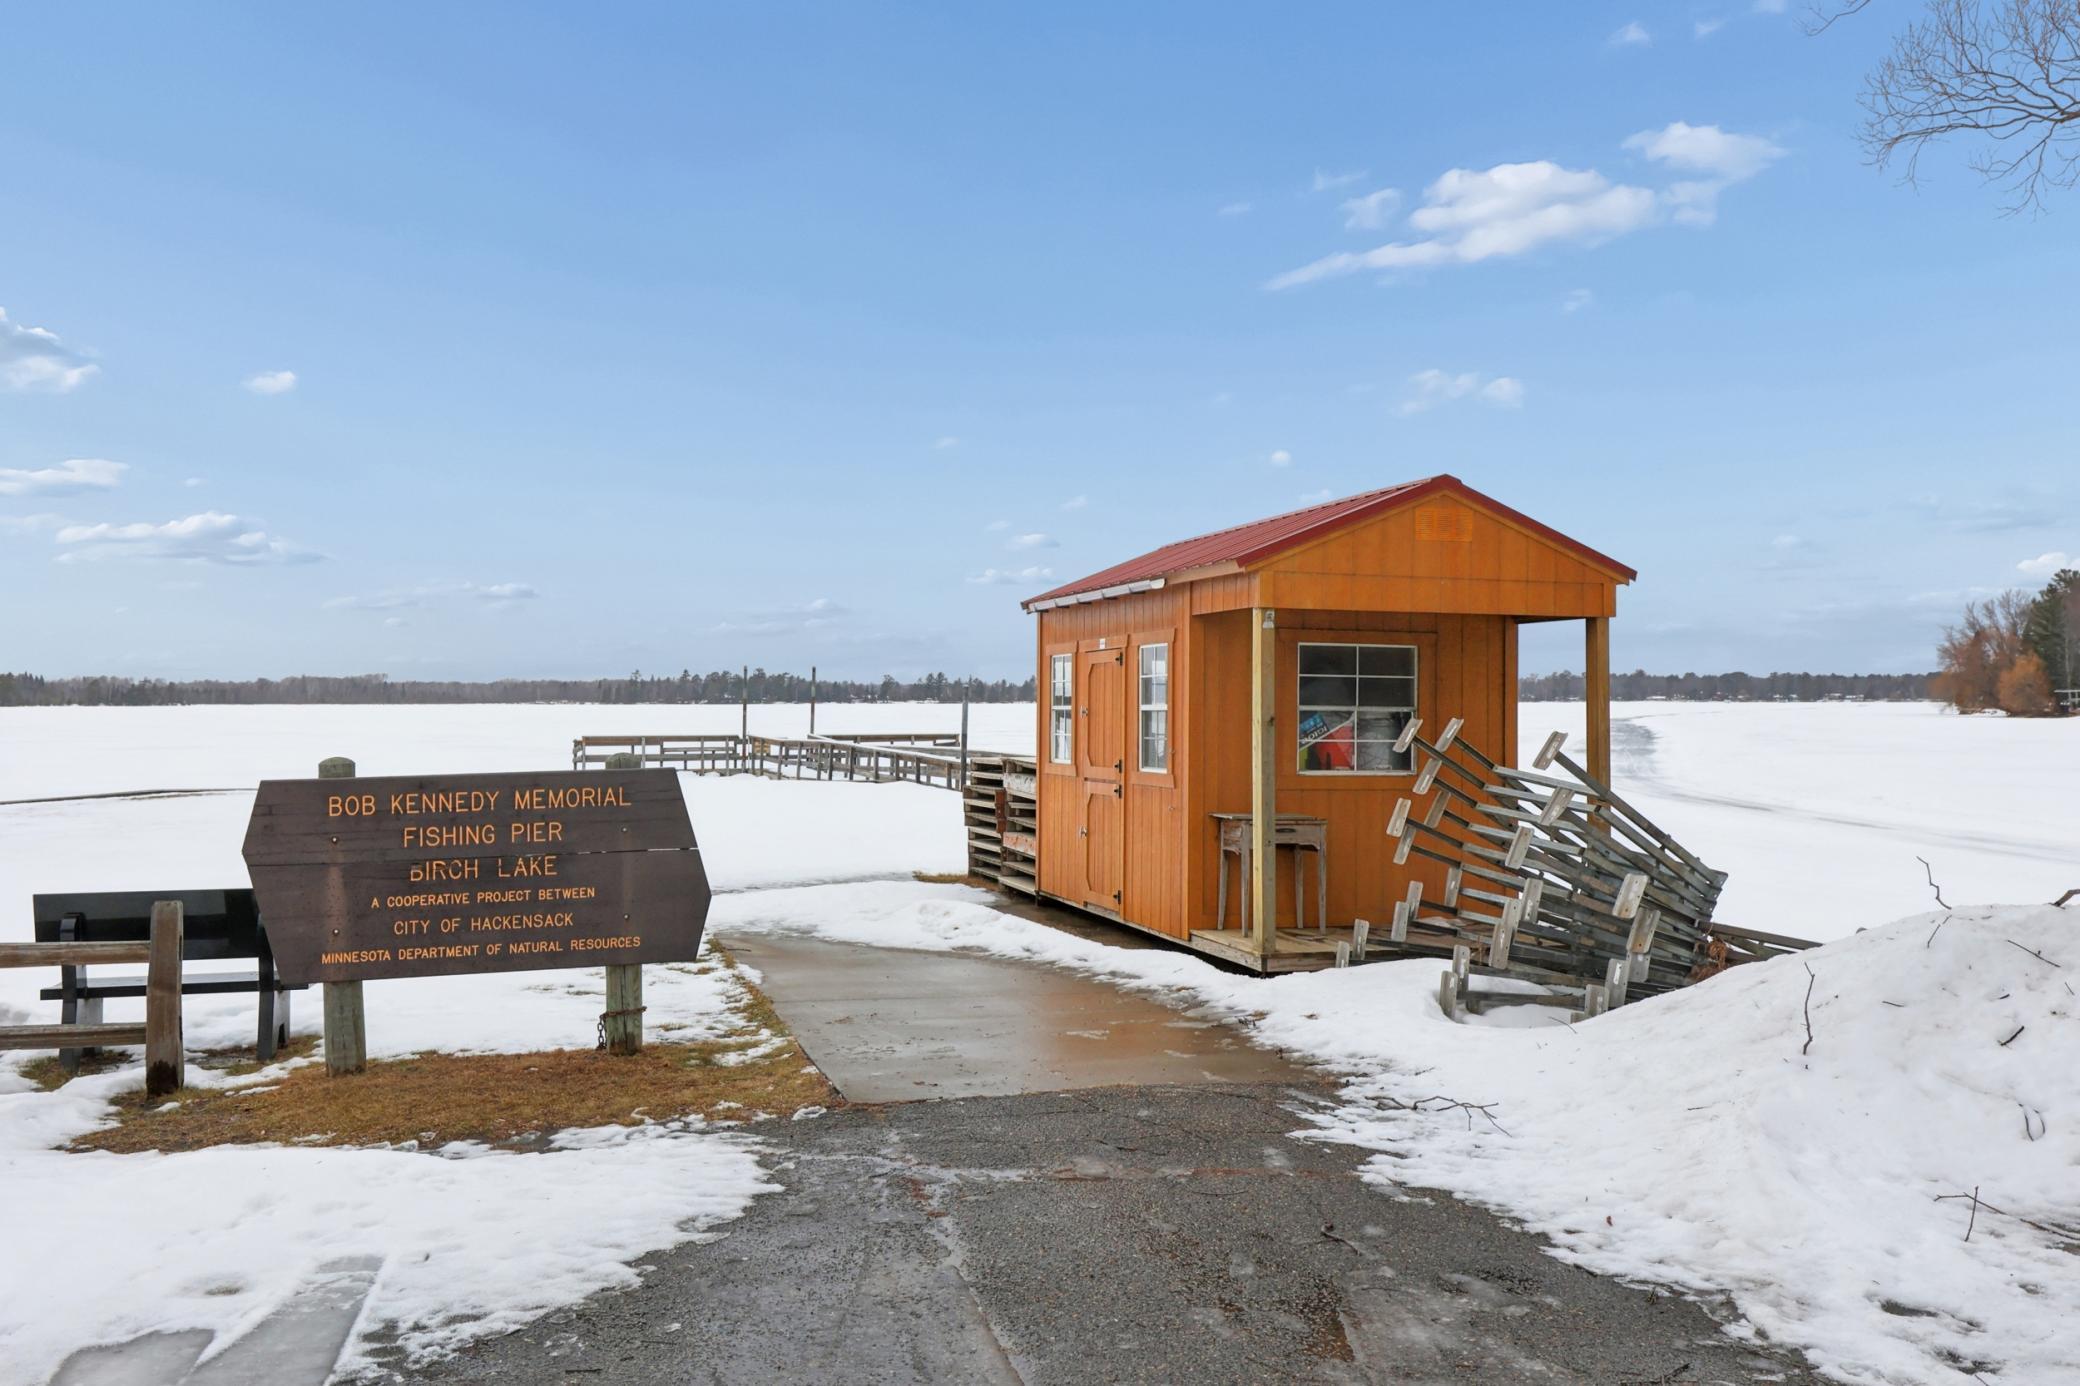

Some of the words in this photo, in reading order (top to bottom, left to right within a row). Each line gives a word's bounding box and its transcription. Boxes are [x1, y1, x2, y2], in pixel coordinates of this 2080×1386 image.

[328, 794, 376, 817] BOB
[391, 791, 500, 814] KENNEDY
[514, 787, 632, 810] MEMORIAL
[403, 824, 496, 848] FISHING
[511, 821, 562, 842] PIER
[410, 859, 479, 882] BIRCH
[498, 855, 558, 878] LAKE
[371, 897, 380, 908] A
[386, 892, 469, 908] COOPERATIVE
[476, 889, 531, 902] PROJECT
[538, 887, 595, 901] BETWEEN
[394, 919, 430, 935] CITY
[441, 918, 460, 933] OF
[471, 912, 572, 929] HACKENSACK
[321, 949, 391, 965] MINNESOTA
[398, 944, 479, 961] DEPARTMENT
[486, 943, 501, 955] OF
[509, 940, 563, 953] NATURAL
[570, 936, 641, 950] RESOURCES
